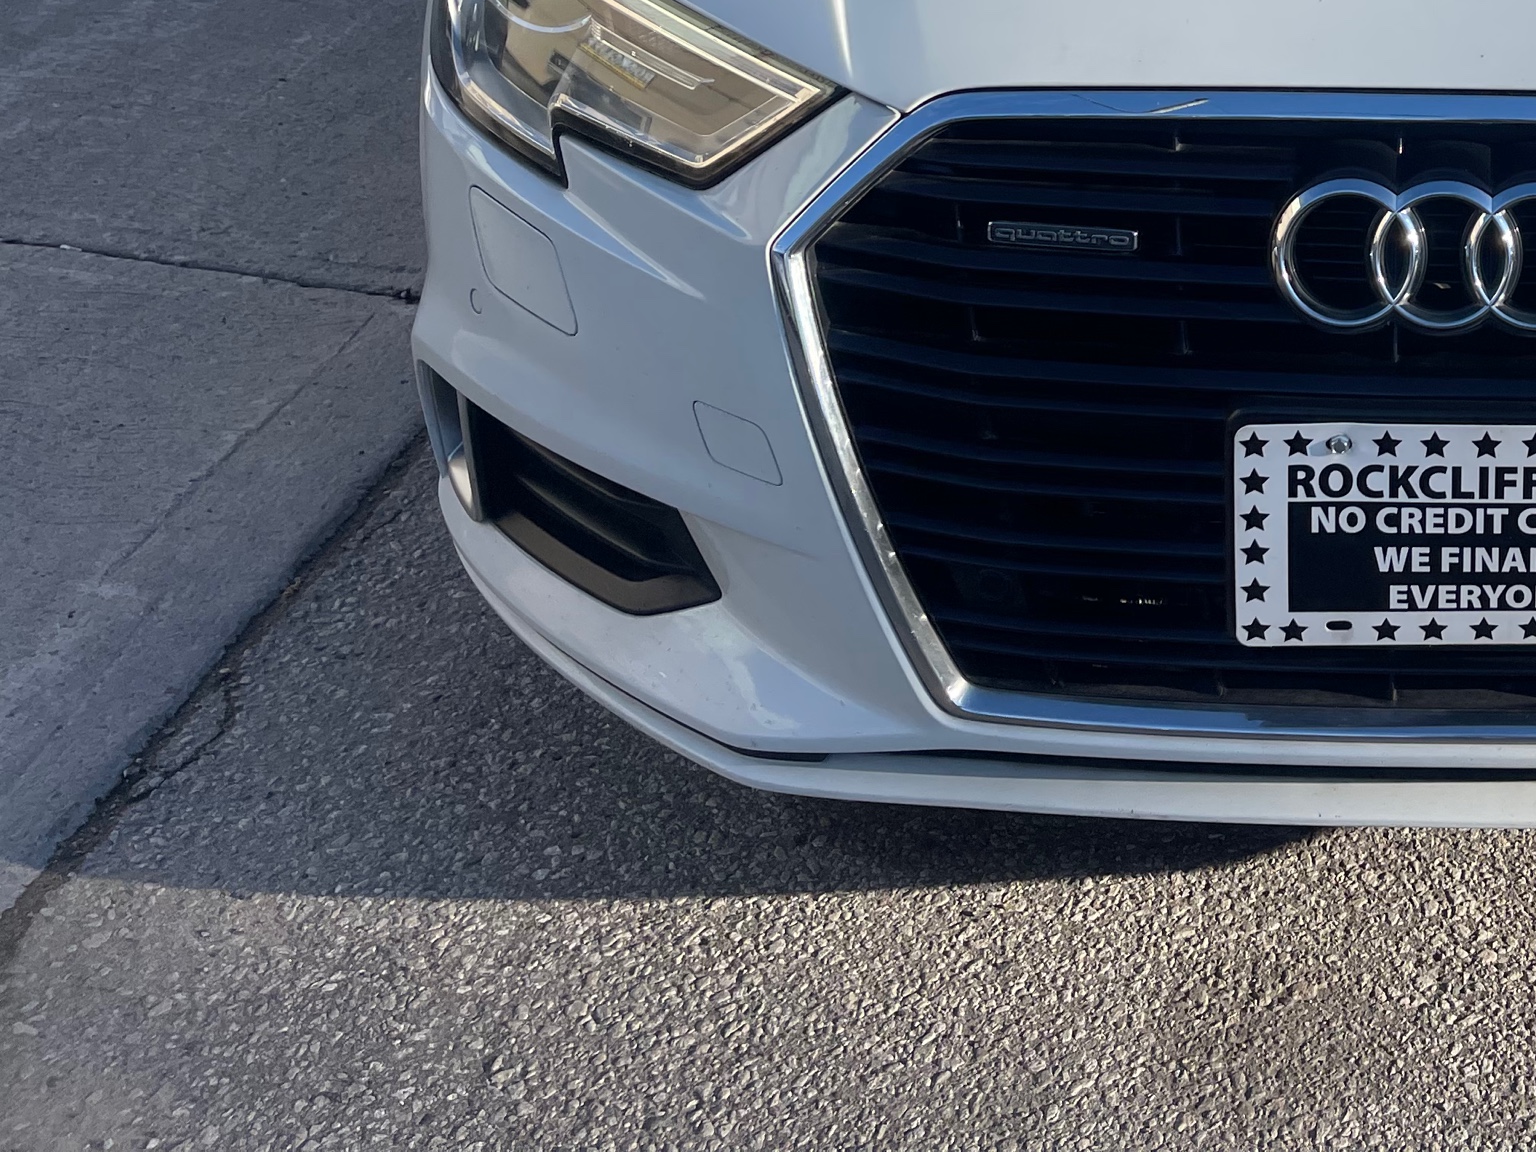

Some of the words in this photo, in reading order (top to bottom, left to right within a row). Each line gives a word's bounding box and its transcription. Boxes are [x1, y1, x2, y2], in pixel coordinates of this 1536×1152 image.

[994, 227, 1130, 247] quattro
[1310, 506, 1367, 534] NO
[1375, 506, 1509, 535] CREDIT
[1373, 546, 1431, 574] WE
